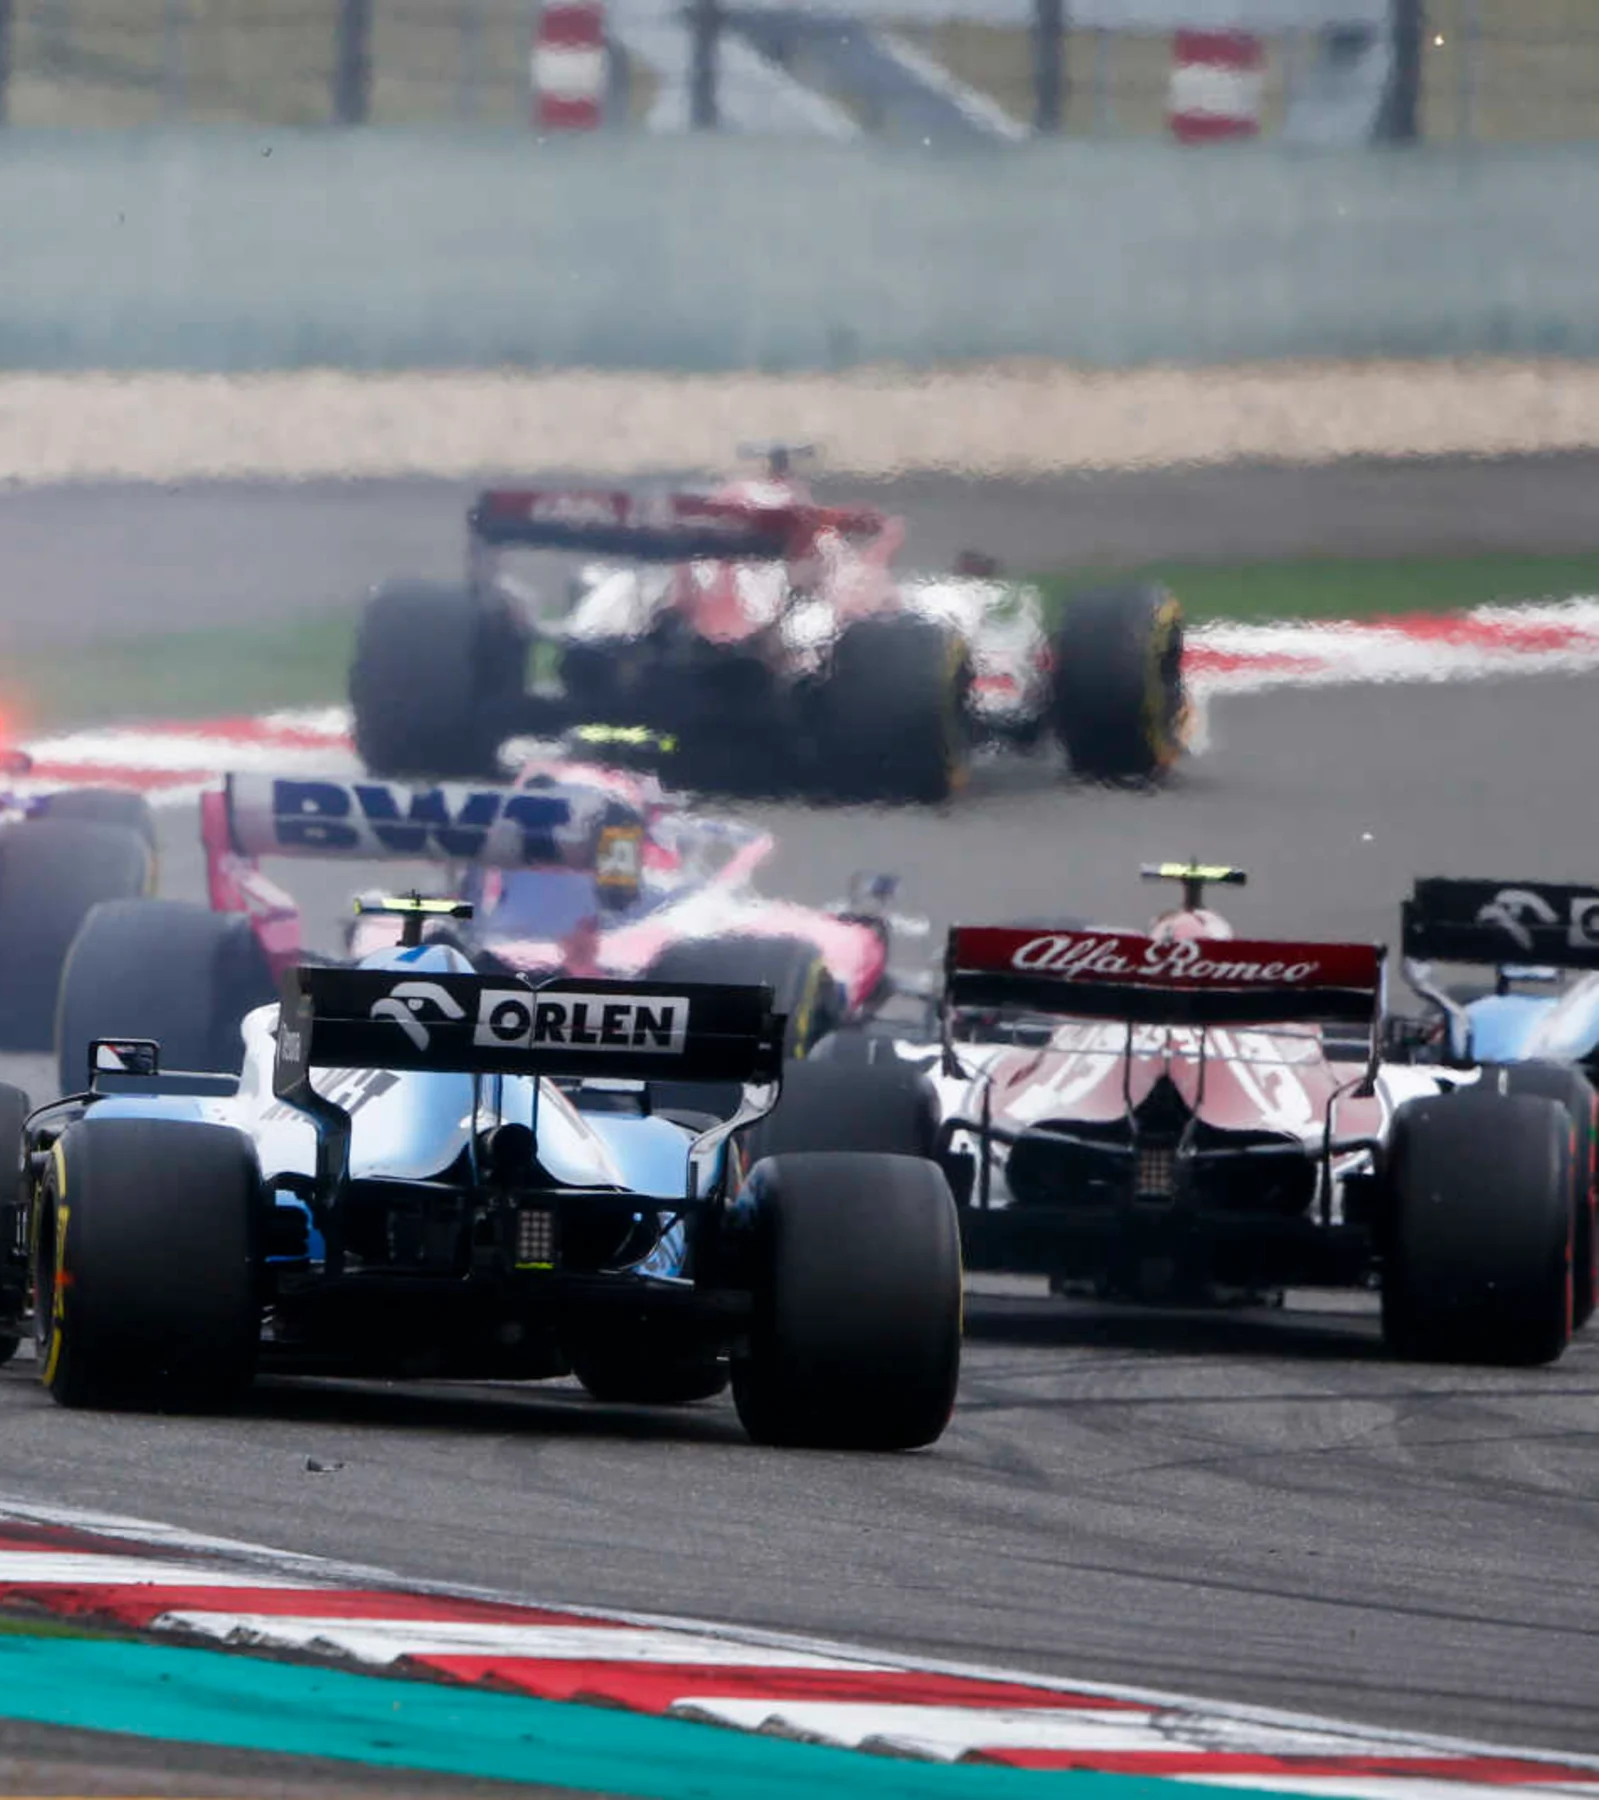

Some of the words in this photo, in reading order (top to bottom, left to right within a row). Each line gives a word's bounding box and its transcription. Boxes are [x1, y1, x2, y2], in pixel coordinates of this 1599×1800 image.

[273, 779, 572, 864] BWT
[1011, 934, 1136, 982] Alfa
[1139, 937, 1320, 983] Romeo
[488, 998, 677, 1048] ORLEN
